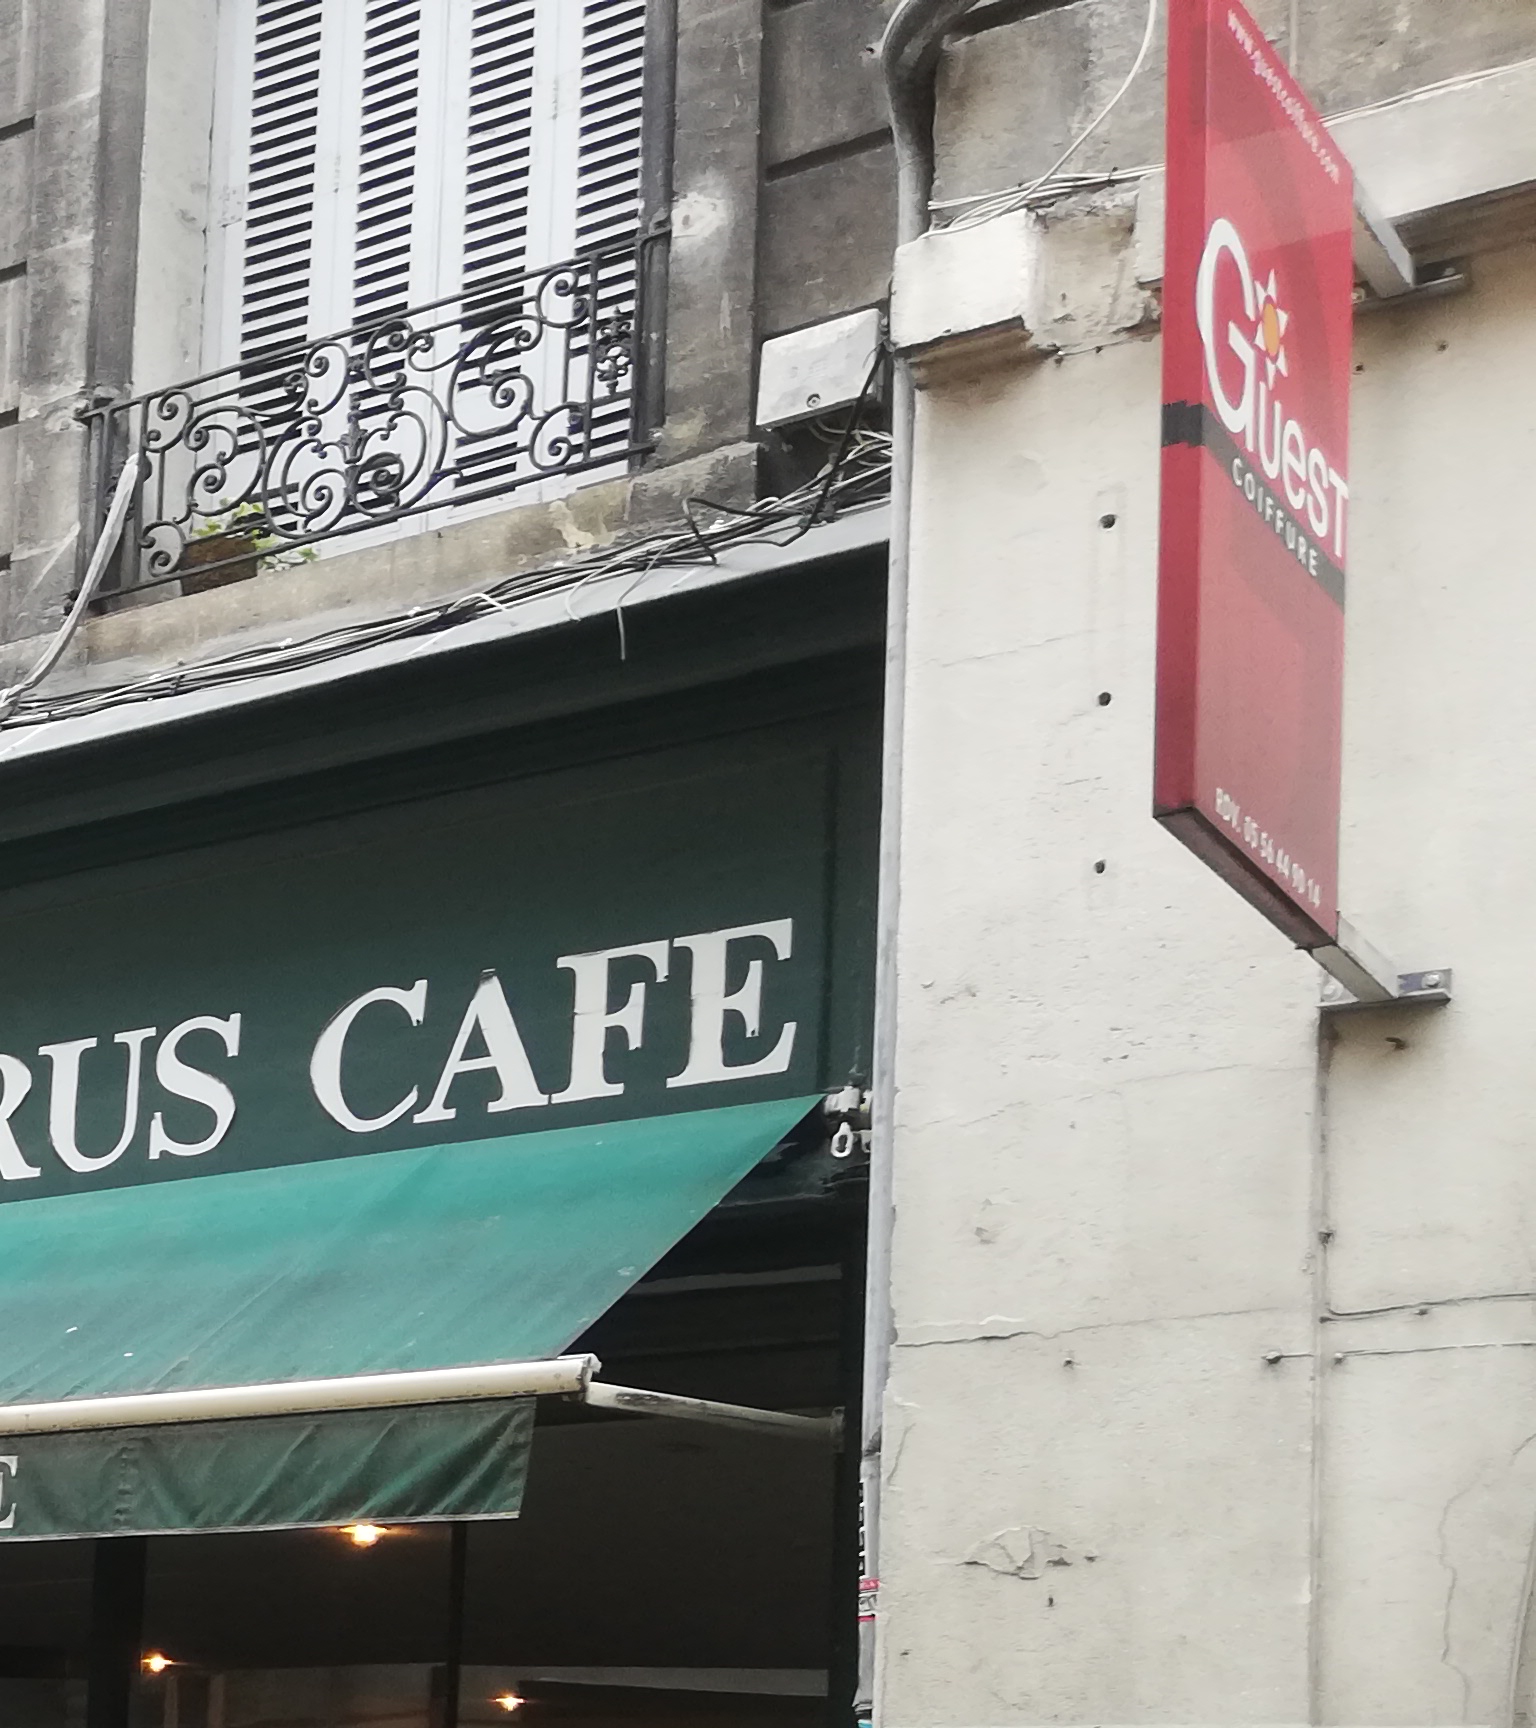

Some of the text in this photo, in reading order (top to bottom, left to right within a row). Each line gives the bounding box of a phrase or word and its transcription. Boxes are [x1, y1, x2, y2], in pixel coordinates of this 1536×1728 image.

[1232, 458, 1317, 577] COIFFURE
[1244, 816, 1260, 848] 05
[1260, 832, 1274, 863] 56
[1276, 849, 1290, 878] 44
[1308, 879, 1320, 908] 14
[309, 916, 796, 1136] CAFE
